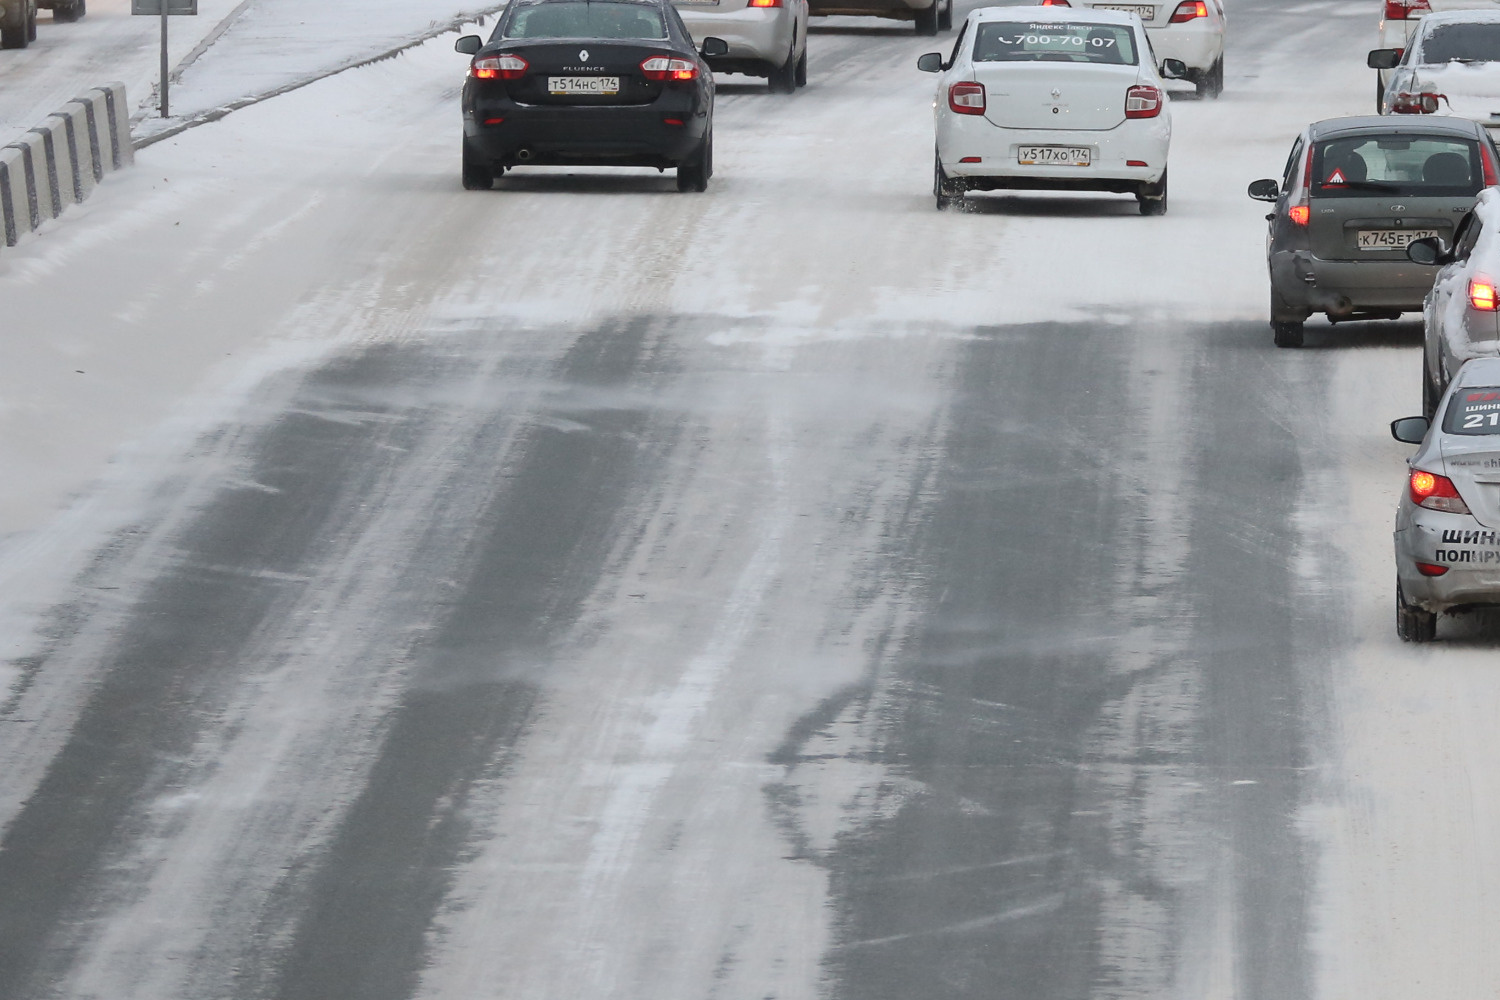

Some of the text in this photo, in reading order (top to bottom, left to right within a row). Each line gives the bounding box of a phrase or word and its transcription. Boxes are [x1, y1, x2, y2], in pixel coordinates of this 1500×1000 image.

[1014, 35, 1116, 48] 700-70-07
[552, 78, 616, 90] Т514НС 174
[1023, 149, 1088, 161] У517ХО 174
[1362, 232, 1413, 245] К745ЕТ
